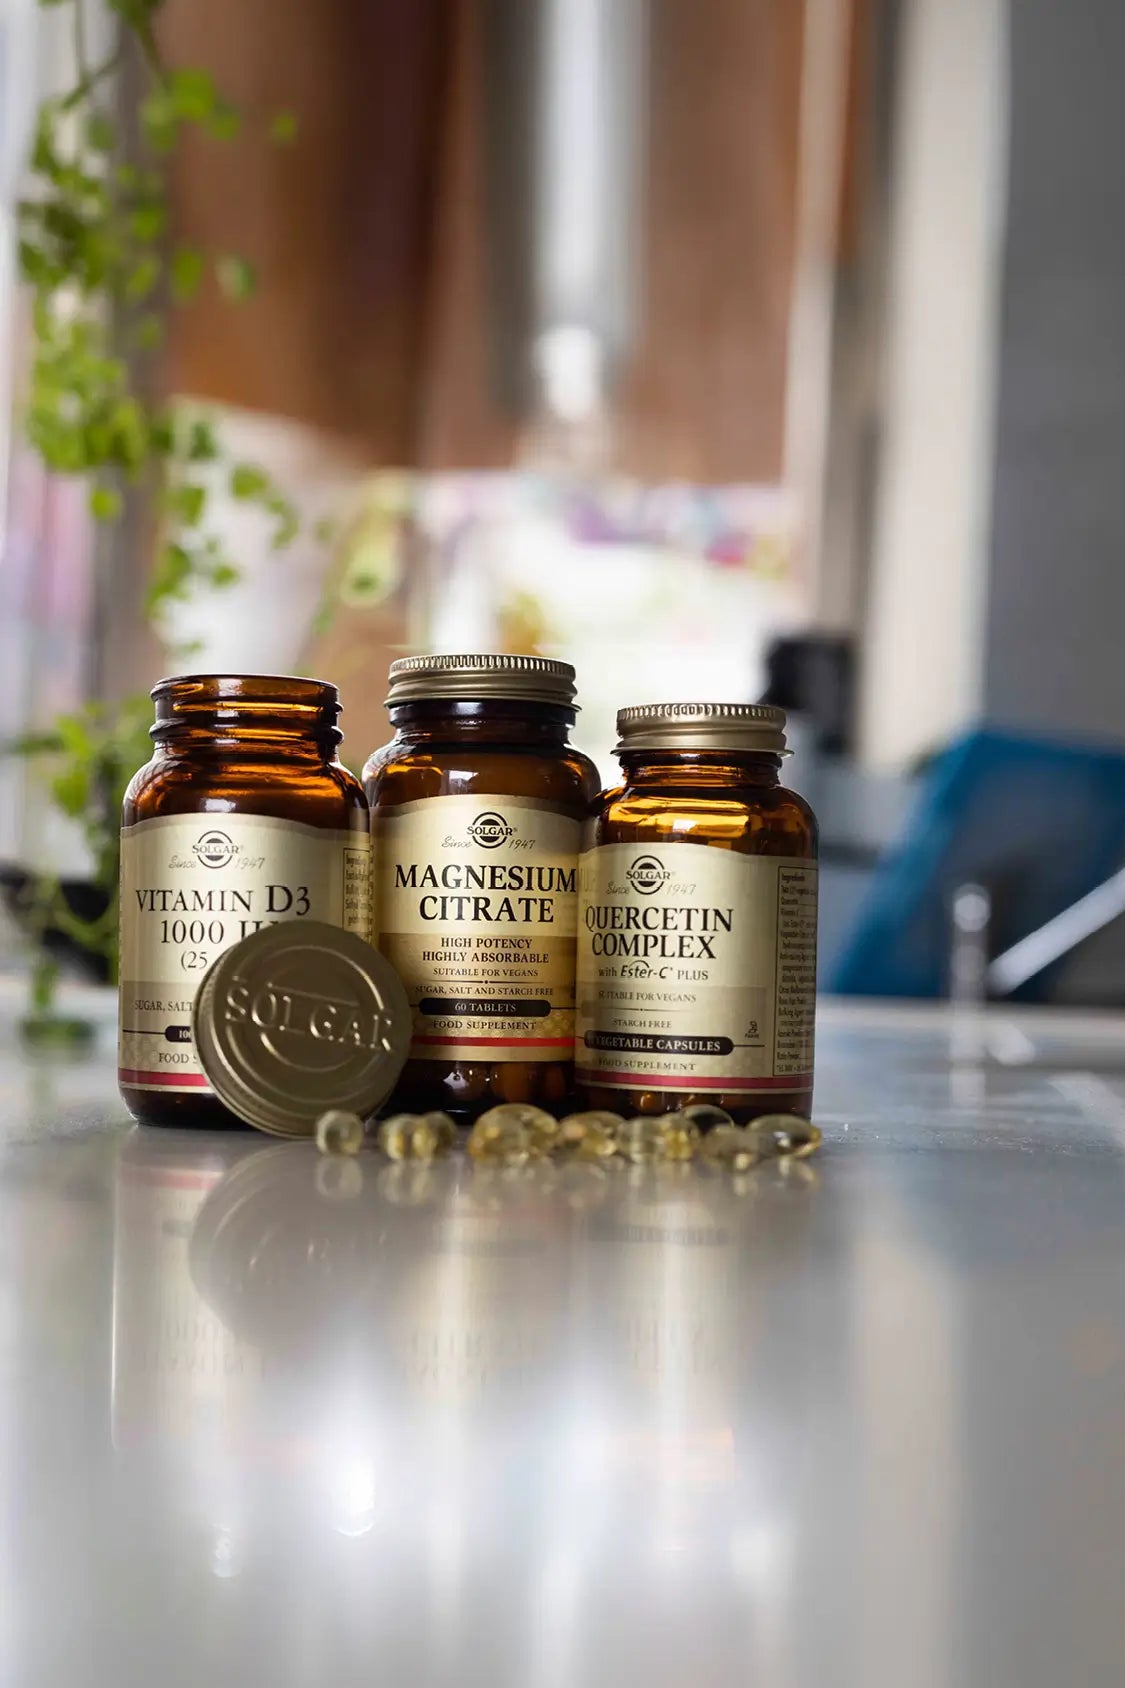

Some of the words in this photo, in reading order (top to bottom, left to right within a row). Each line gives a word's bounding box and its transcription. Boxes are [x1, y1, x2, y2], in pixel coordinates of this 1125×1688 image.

[467, 825, 513, 836] SOLGAR
[192, 843, 240, 855] SOLGAR
[441, 836, 472, 848] Since
[509, 838, 535, 850] 1947
[168, 854, 197, 869] Since
[395, 864, 576, 892] MAGNESIUM
[626, 870, 671, 880] SOLGAR
[606, 882, 629, 895] Since
[666, 884, 696, 896] 1947
[136, 889, 254, 913] VITAMIN
[265, 885, 311, 915] D3
[419, 896, 554, 923] CITRATE
[585, 906, 734, 933] QUERCETIN
[161, 919, 224, 944] 1000
[441, 937, 472, 948] HIGH
[476, 938, 532, 949] POTENCY
[592, 933, 716, 959] COMPLEX
[181, 951, 208, 971] (25
[422, 951, 467, 962] HIGHLY
[471, 952, 549, 964] ABSORBABLE
[433, 968, 479, 977] SUITABLE
[482, 968, 500, 977] FOR
[503, 968, 539, 977] VEGANS
[598, 967, 617, 977] with
[677, 970, 709, 980] PLUS
[449, 986, 471, 995] SALT
[473, 987, 495, 995] AND
[497, 987, 534, 996] STARCH
[535, 988, 553, 996] FREE
[636, 992, 655, 1001] FOR
[656, 993, 697, 1002] VEGANS
[135, 1000, 166, 1012] SUGAR,
[454, 1002, 467, 1012] 60
[469, 1002, 516, 1013] TABLETS
[433, 1020, 463, 1029] FOOD
[466, 1021, 537, 1030] SUPPLEMENT
[613, 1019, 646, 1028] STARCH
[648, 1020, 672, 1028] FREE
[656, 1039, 721, 1052] CAPSULES
[159, 1053, 189, 1063] FOOD
[624, 1060, 696, 1070] SUPPLEMENT
